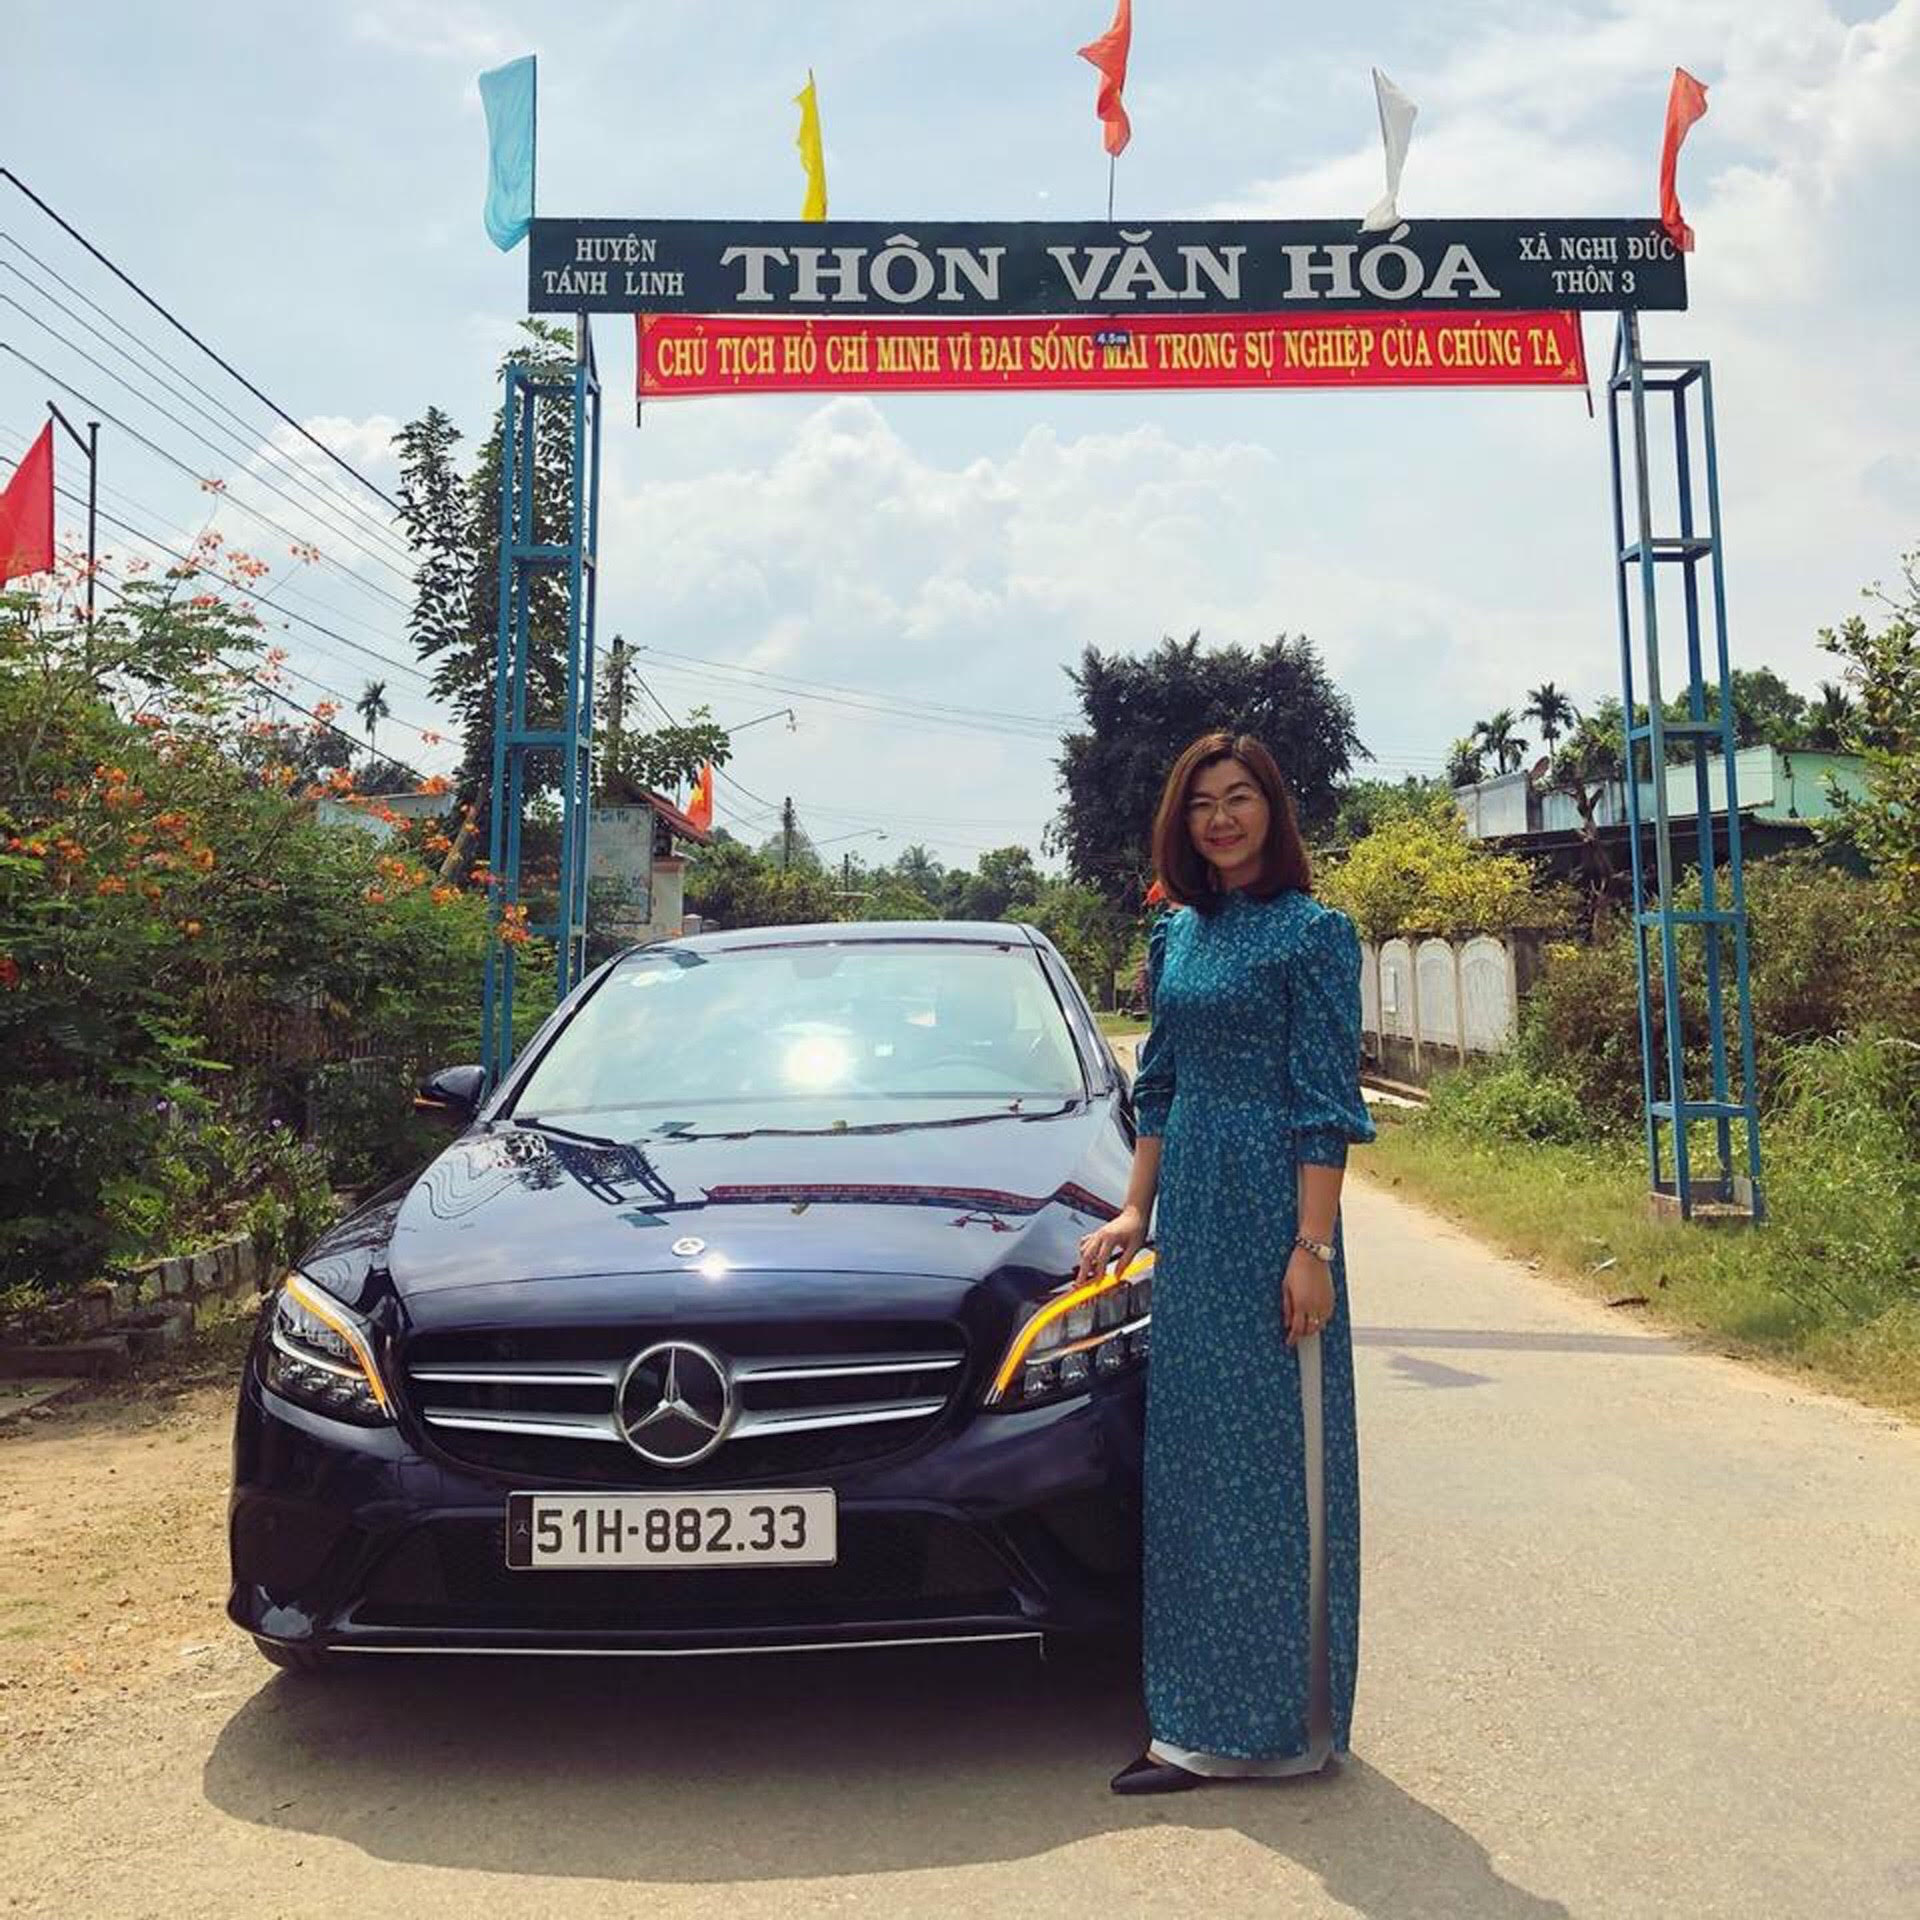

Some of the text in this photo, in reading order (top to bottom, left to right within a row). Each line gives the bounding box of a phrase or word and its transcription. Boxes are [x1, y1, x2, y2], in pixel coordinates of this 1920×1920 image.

[576, 233, 656, 266] HUYỆN
[720, 222, 1501, 303] THÔN VĂN HÓA
[1519, 230, 1675, 264] XÃ NGHỊ ĐỨC
[542, 264, 685, 296] TÁNH LINH
[1552, 264, 1635, 293] THÔN 3
[658, 325, 708, 377] CHỦ
[716, 336, 775, 385] TỊCH
[783, 320, 817, 374] HỒ
[826, 329, 869, 374] CHÍ
[876, 335, 941, 372] MINH
[947, 332, 973, 371] VĨ
[980, 335, 1023, 381] ĐẠI
[1030, 322, 1095, 371] SỐNG
[1155, 332, 1238, 369] TRONG
[1245, 328, 1275, 379] SỰ
[1283, 325, 1375, 377] NGHIỆP
[1382, 319, 1433, 367] CỦA
[1438, 319, 1521, 366] CHÚNG
[1528, 328, 1562, 366] TA
[537, 1505, 807, 1553] 51H-882.33
